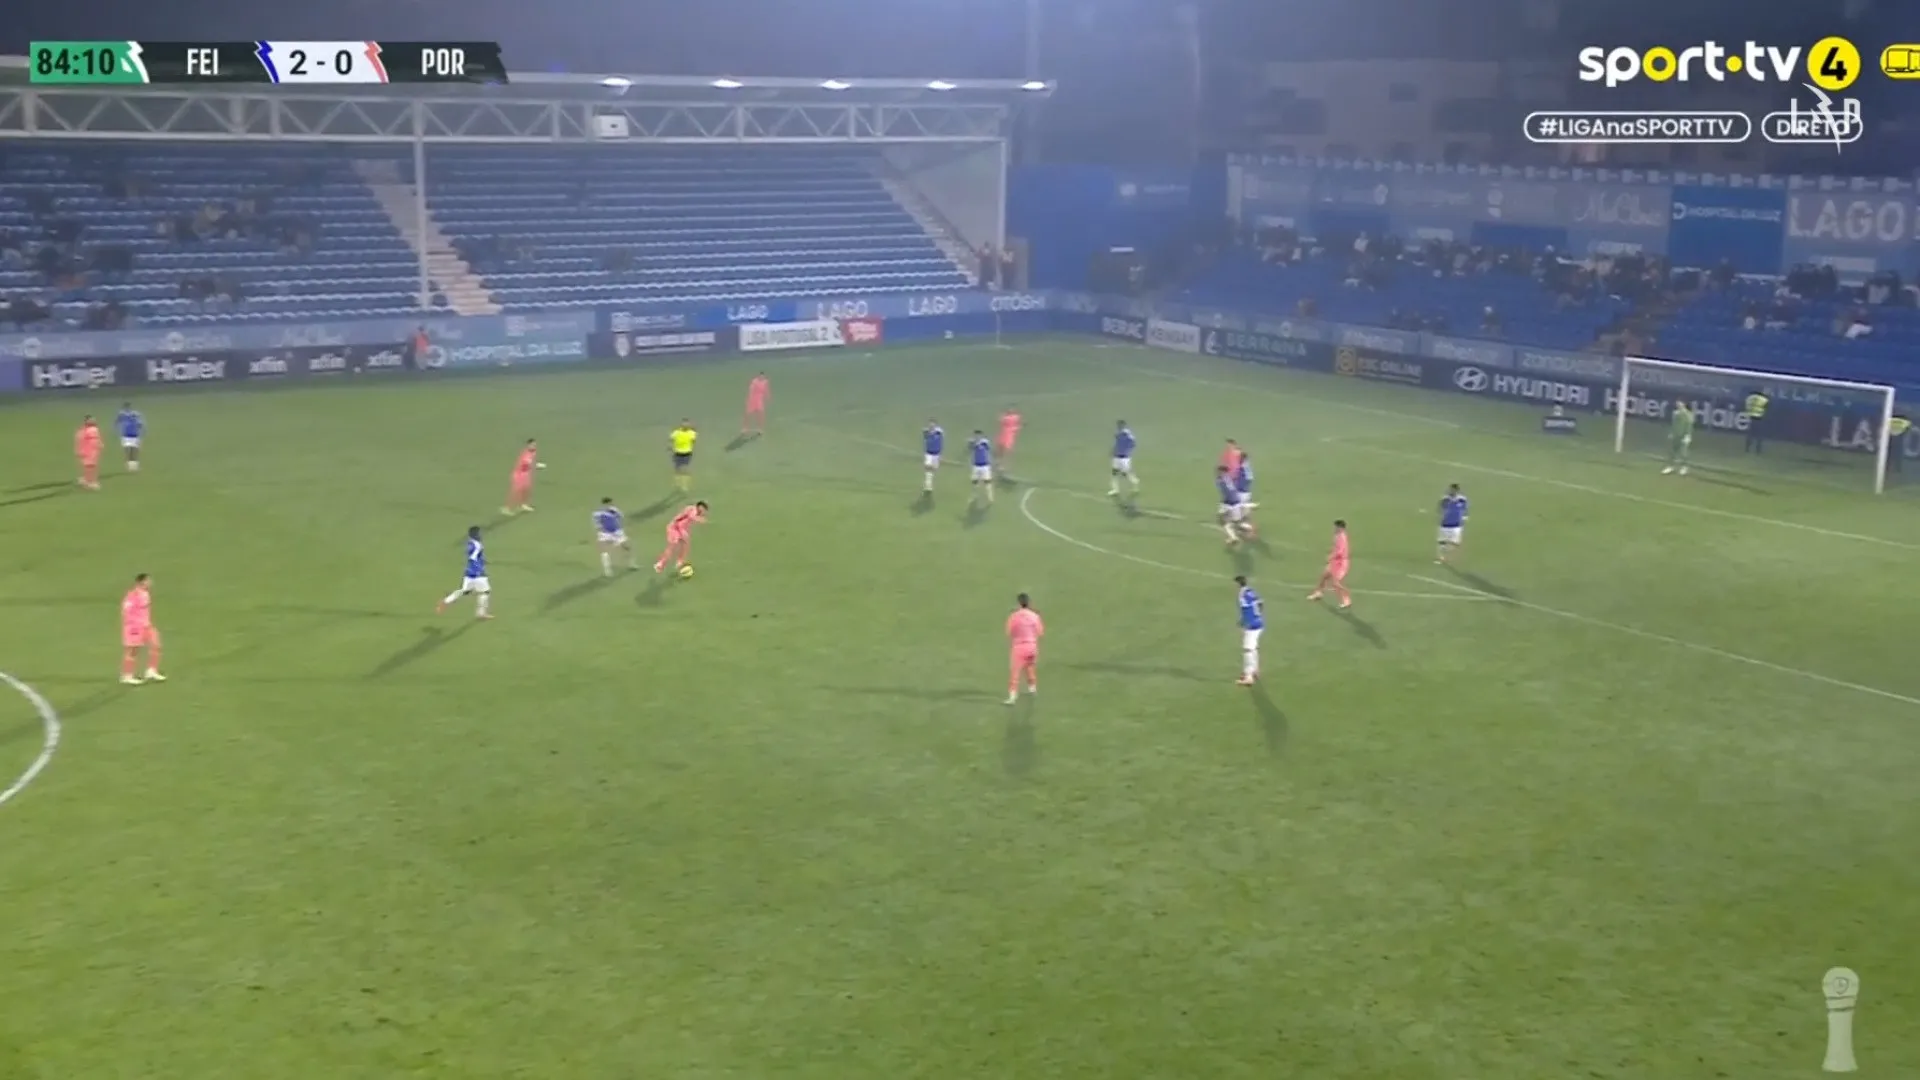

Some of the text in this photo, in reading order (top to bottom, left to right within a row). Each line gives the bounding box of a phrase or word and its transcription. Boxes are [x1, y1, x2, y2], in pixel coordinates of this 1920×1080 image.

[1788, 197, 1906, 241] LAGO
[727, 305, 769, 321] LAGO
[816, 301, 869, 320] LAGO
[908, 296, 959, 317] LAGO
[33, 361, 117, 388] Haier
[147, 356, 227, 382] Haier
[1493, 374, 1590, 406] HYUNDAI
[1603, 387, 1668, 419] Haier
[1691, 401, 1751, 431] Haie
